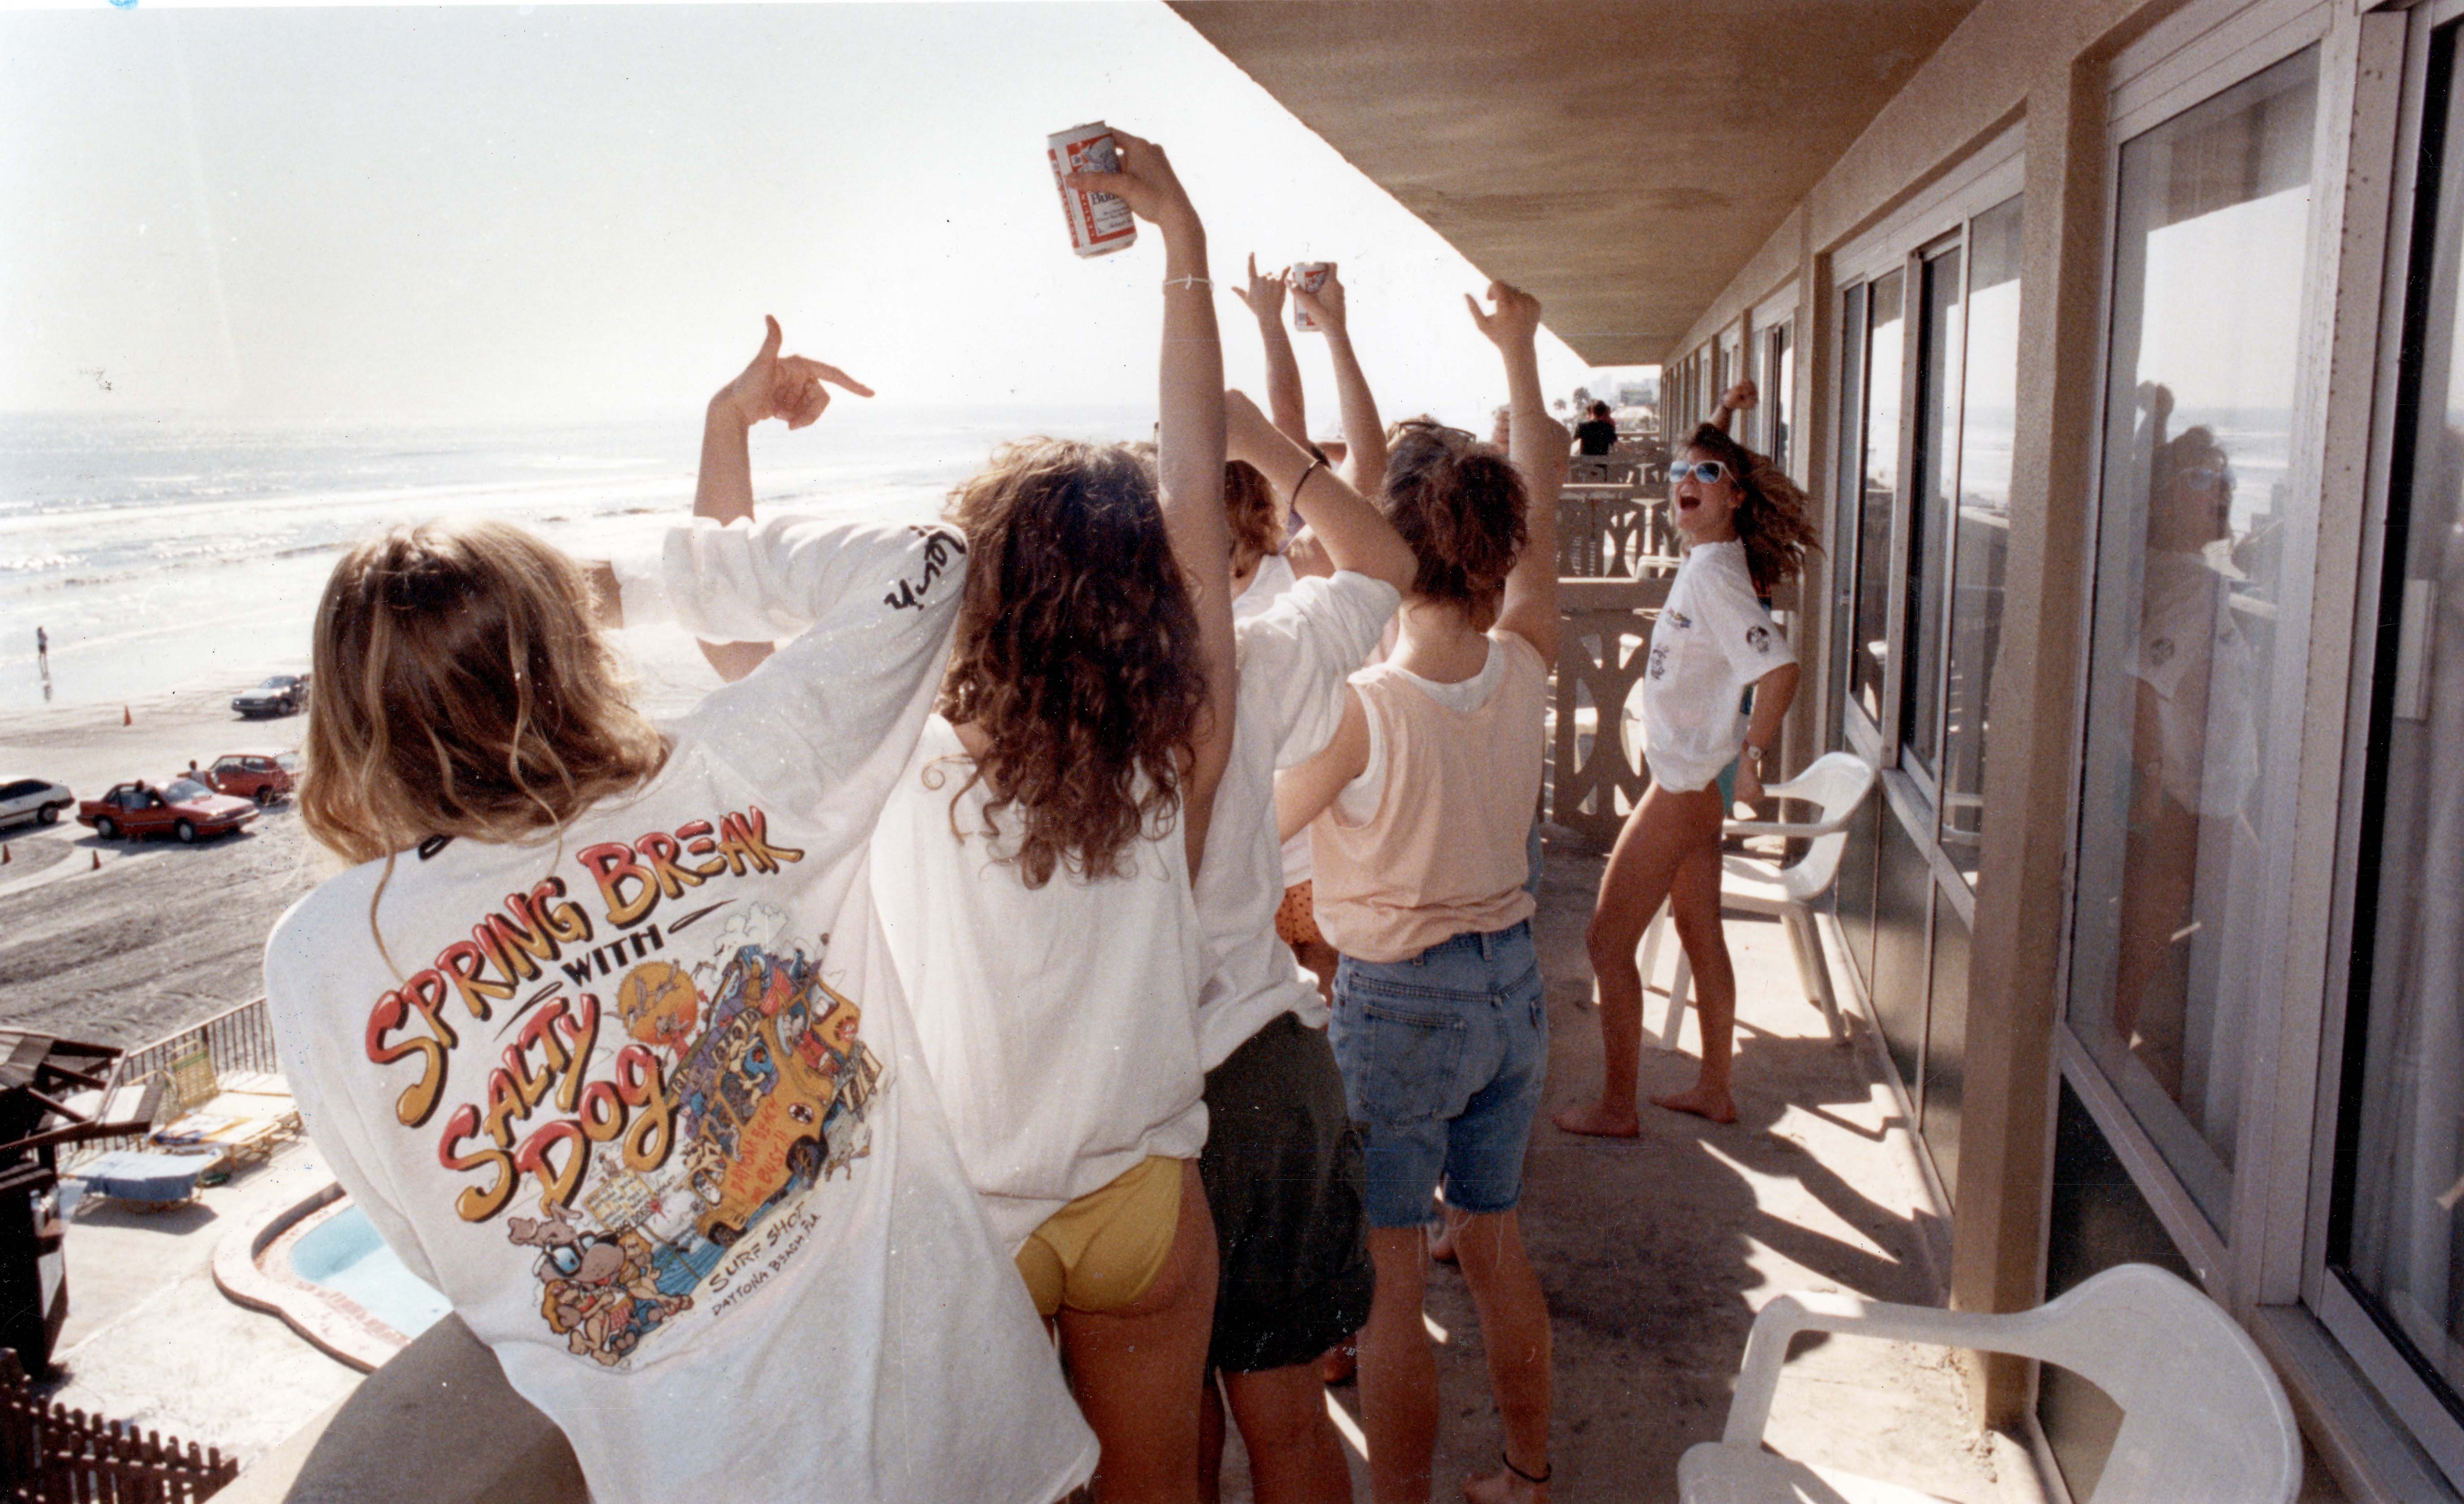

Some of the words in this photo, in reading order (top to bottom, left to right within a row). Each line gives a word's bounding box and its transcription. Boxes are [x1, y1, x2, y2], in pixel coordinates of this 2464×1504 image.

[366, 876, 594, 1128] SPRING
[577, 805, 805, 930] BREAK
[561, 923, 664, 987] WITH
[438, 993, 601, 1223] SALTY
[709, 1242, 760, 1293] SURF
[712, 1271, 768, 1316] DAYTONA
[768, 1235, 804, 1271] BEACH
